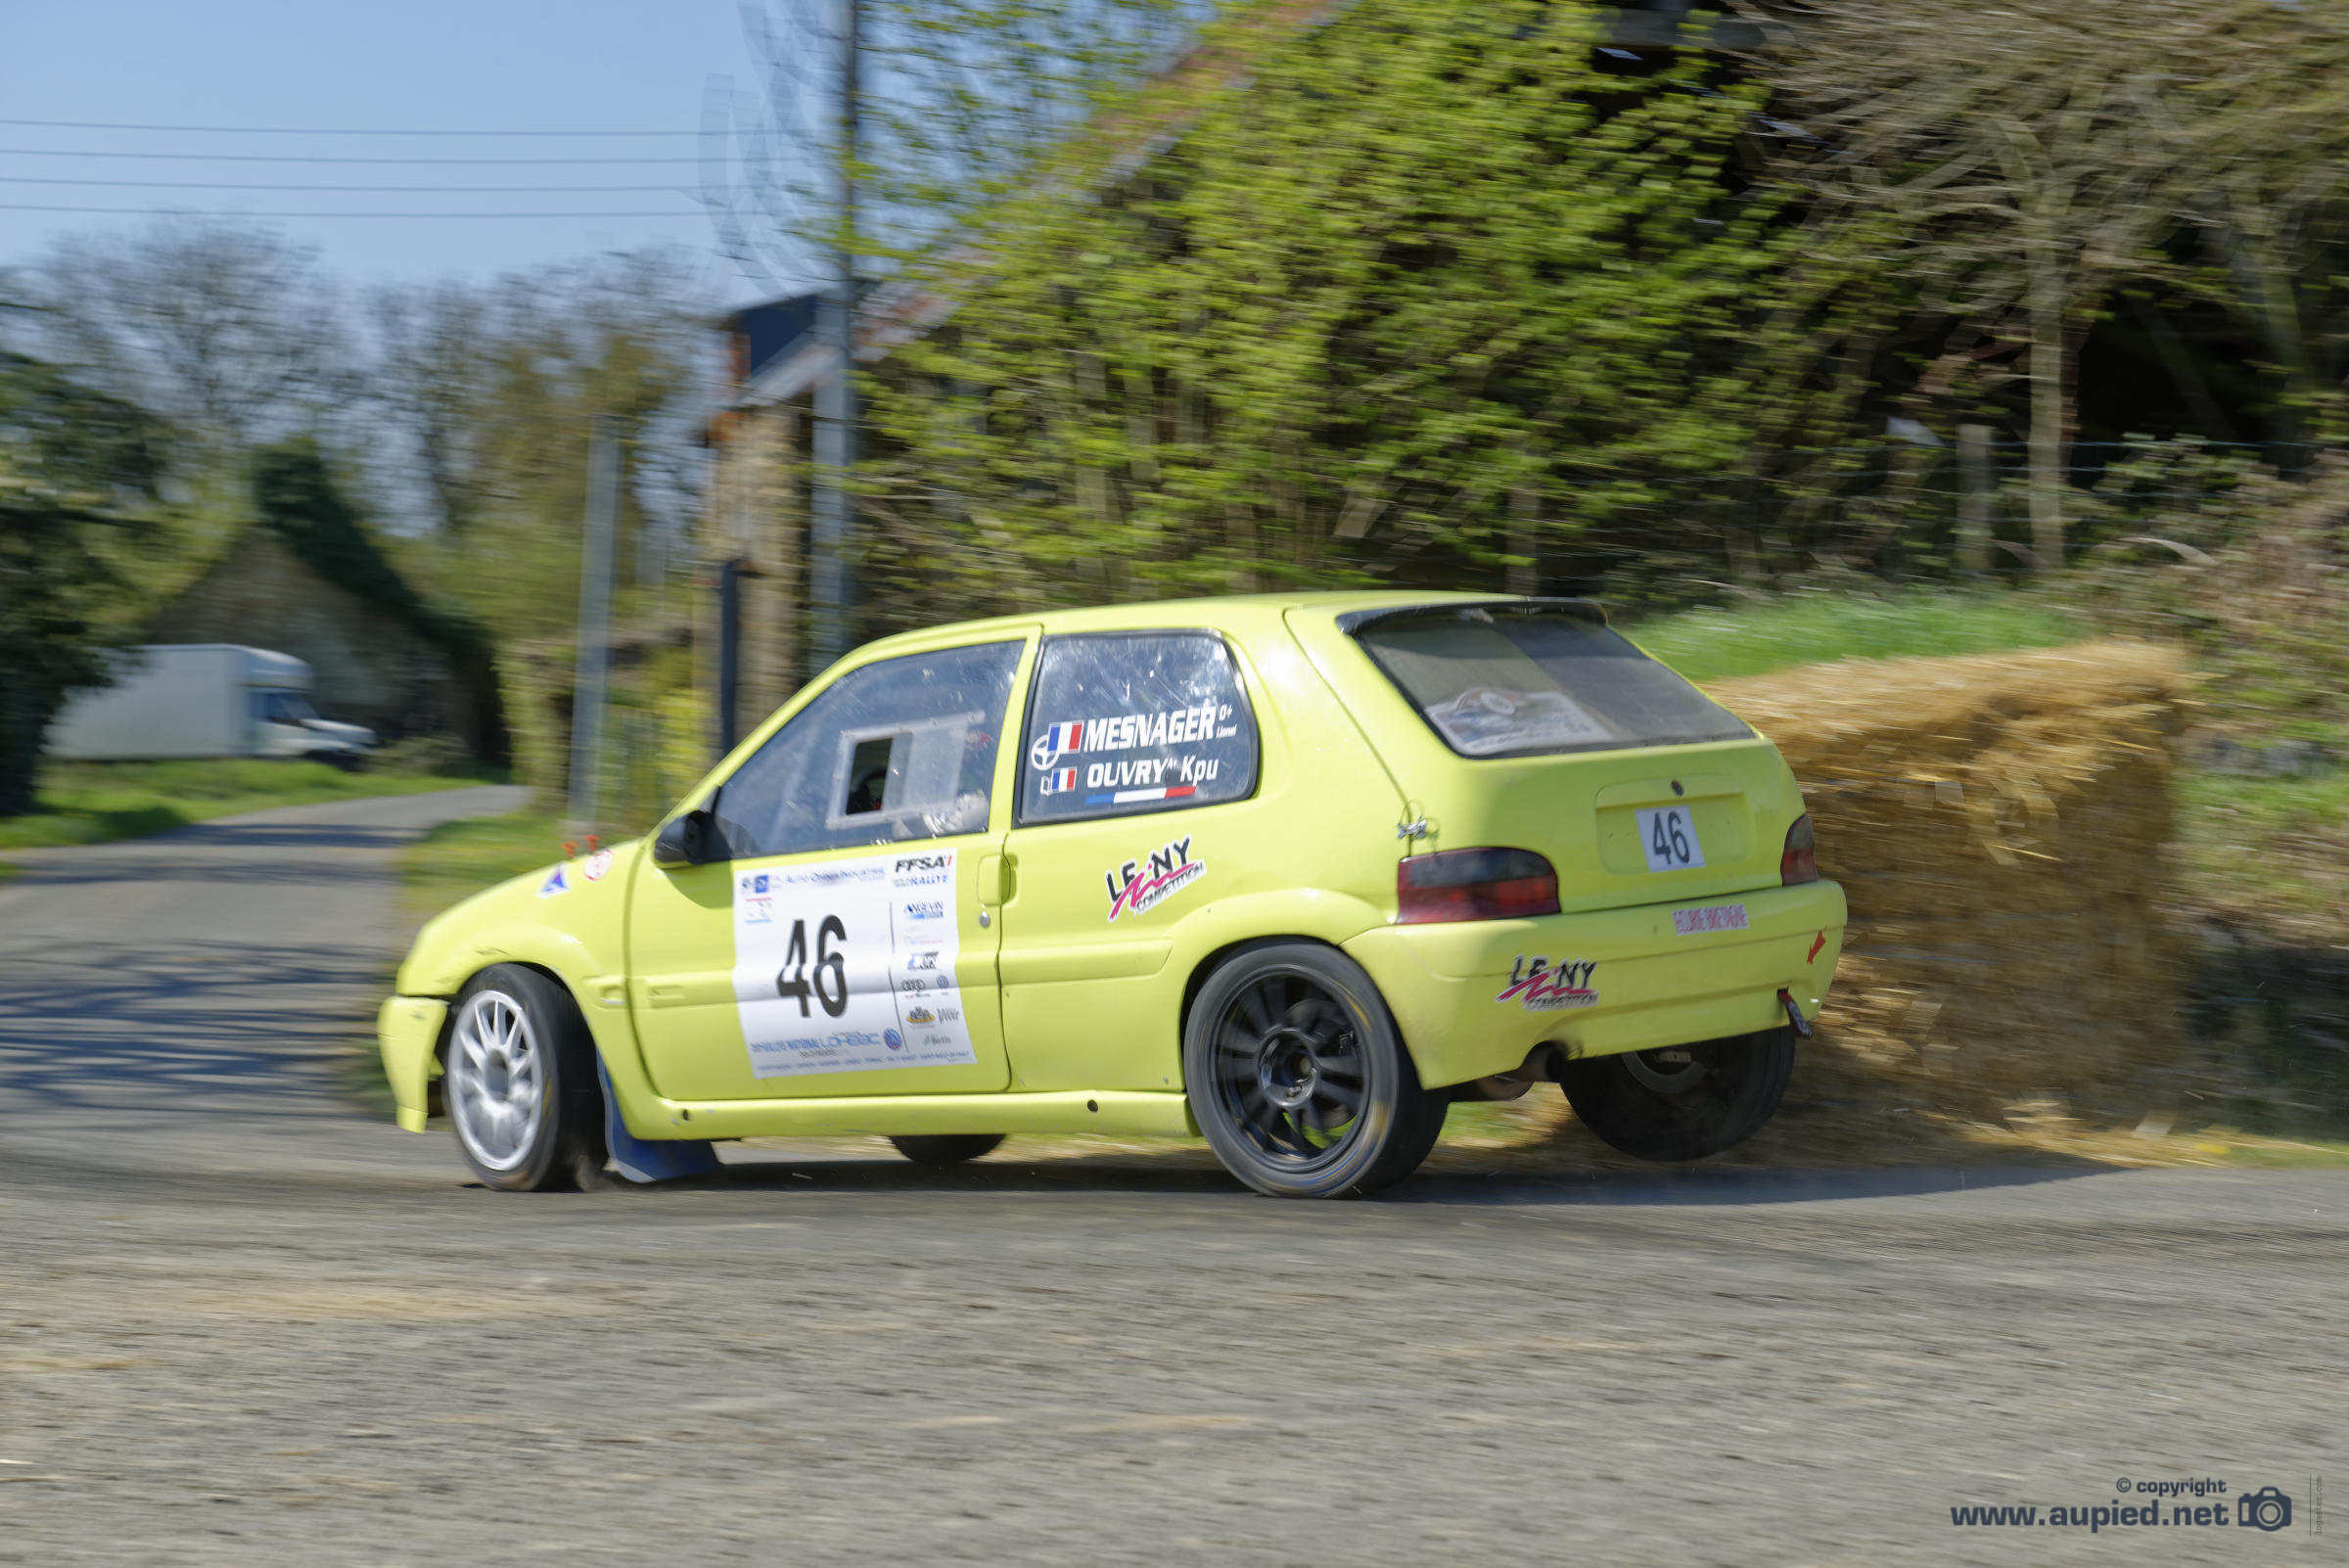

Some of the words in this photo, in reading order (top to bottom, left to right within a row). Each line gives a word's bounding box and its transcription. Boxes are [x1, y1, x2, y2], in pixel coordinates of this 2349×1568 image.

[1084, 706, 1217, 753] MESNAGER
[1086, 758, 1168, 788] OUVRY
[1179, 755, 1220, 786] Kpu
[1651, 809, 1691, 866] 46
[894, 855, 948, 872] FFSA
[776, 914, 849, 1019] 46
